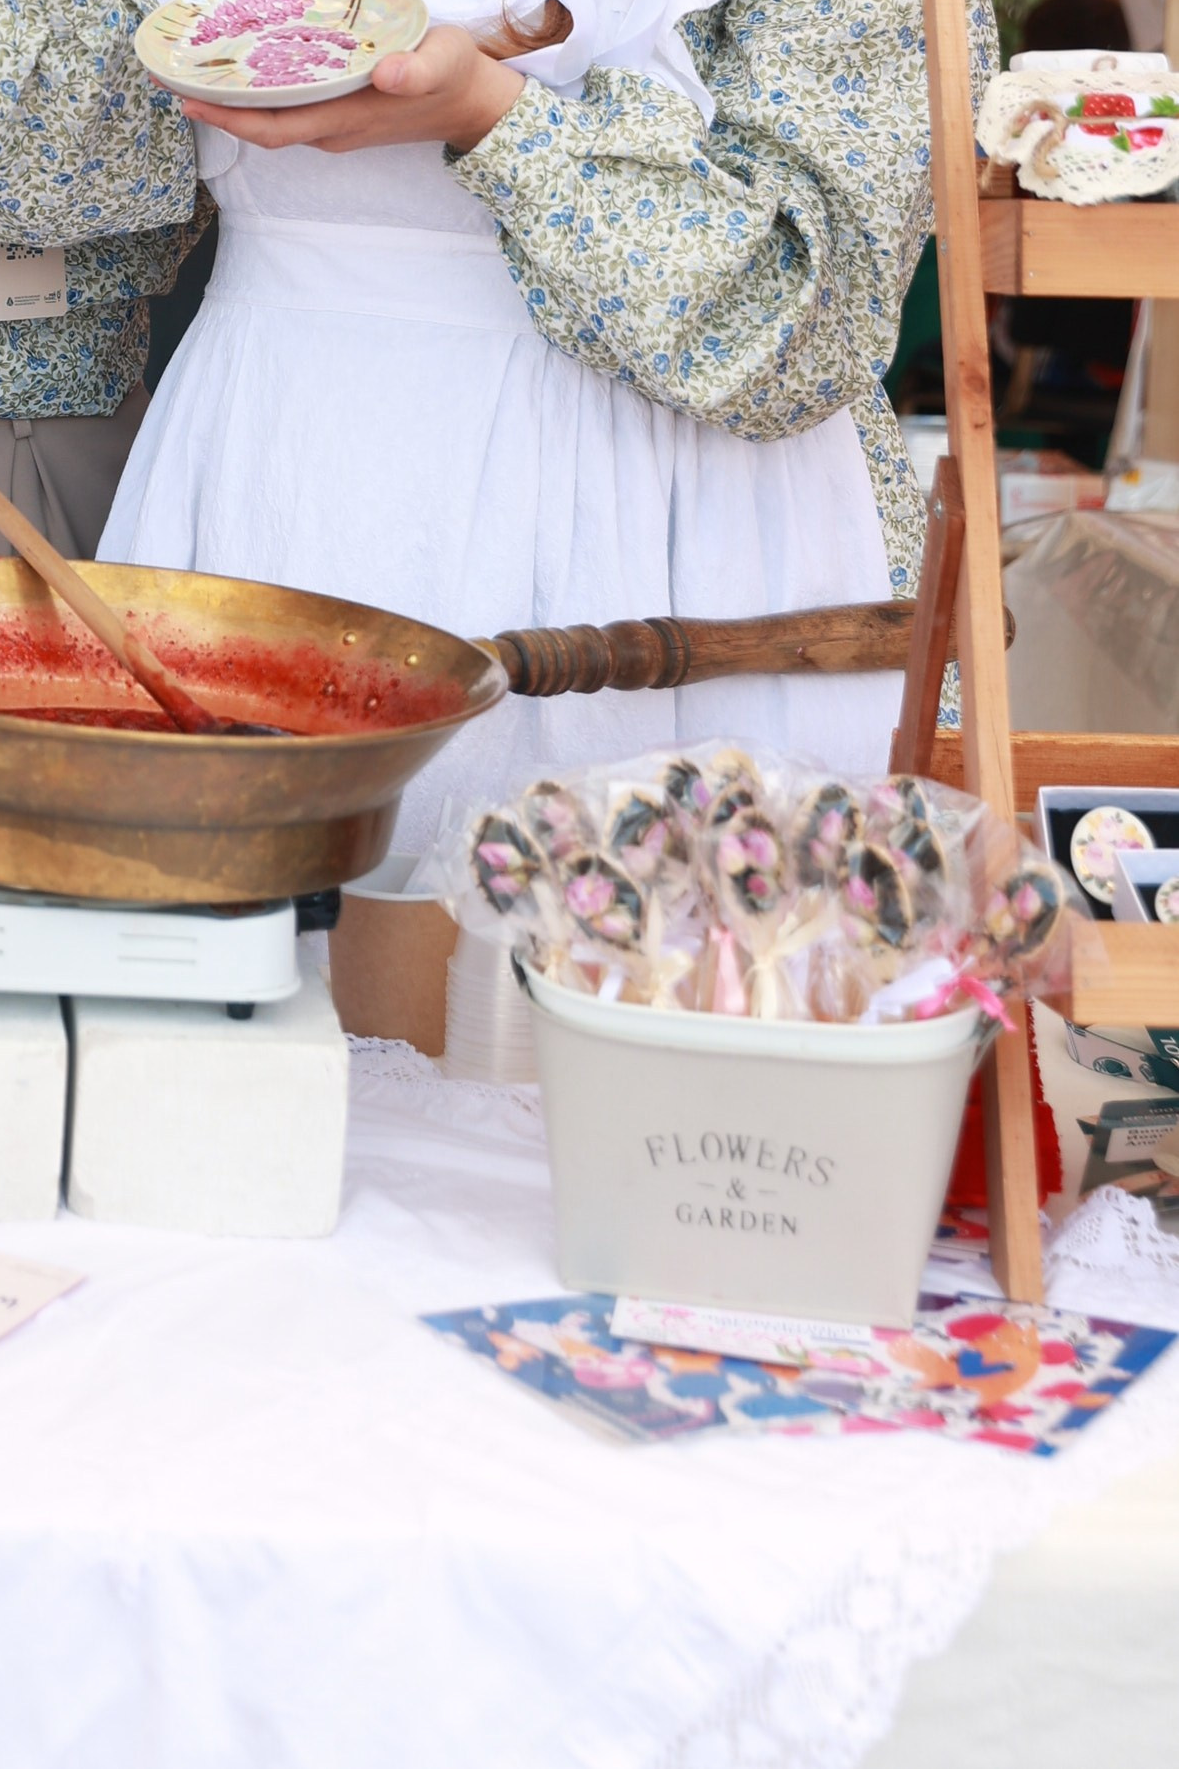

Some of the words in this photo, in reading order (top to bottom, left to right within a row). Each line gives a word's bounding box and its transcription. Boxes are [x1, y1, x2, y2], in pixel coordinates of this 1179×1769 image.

[645, 1131, 839, 1188] FLOWERS
[725, 1177, 747, 1201] &
[674, 1201, 799, 1237] GARDEN
